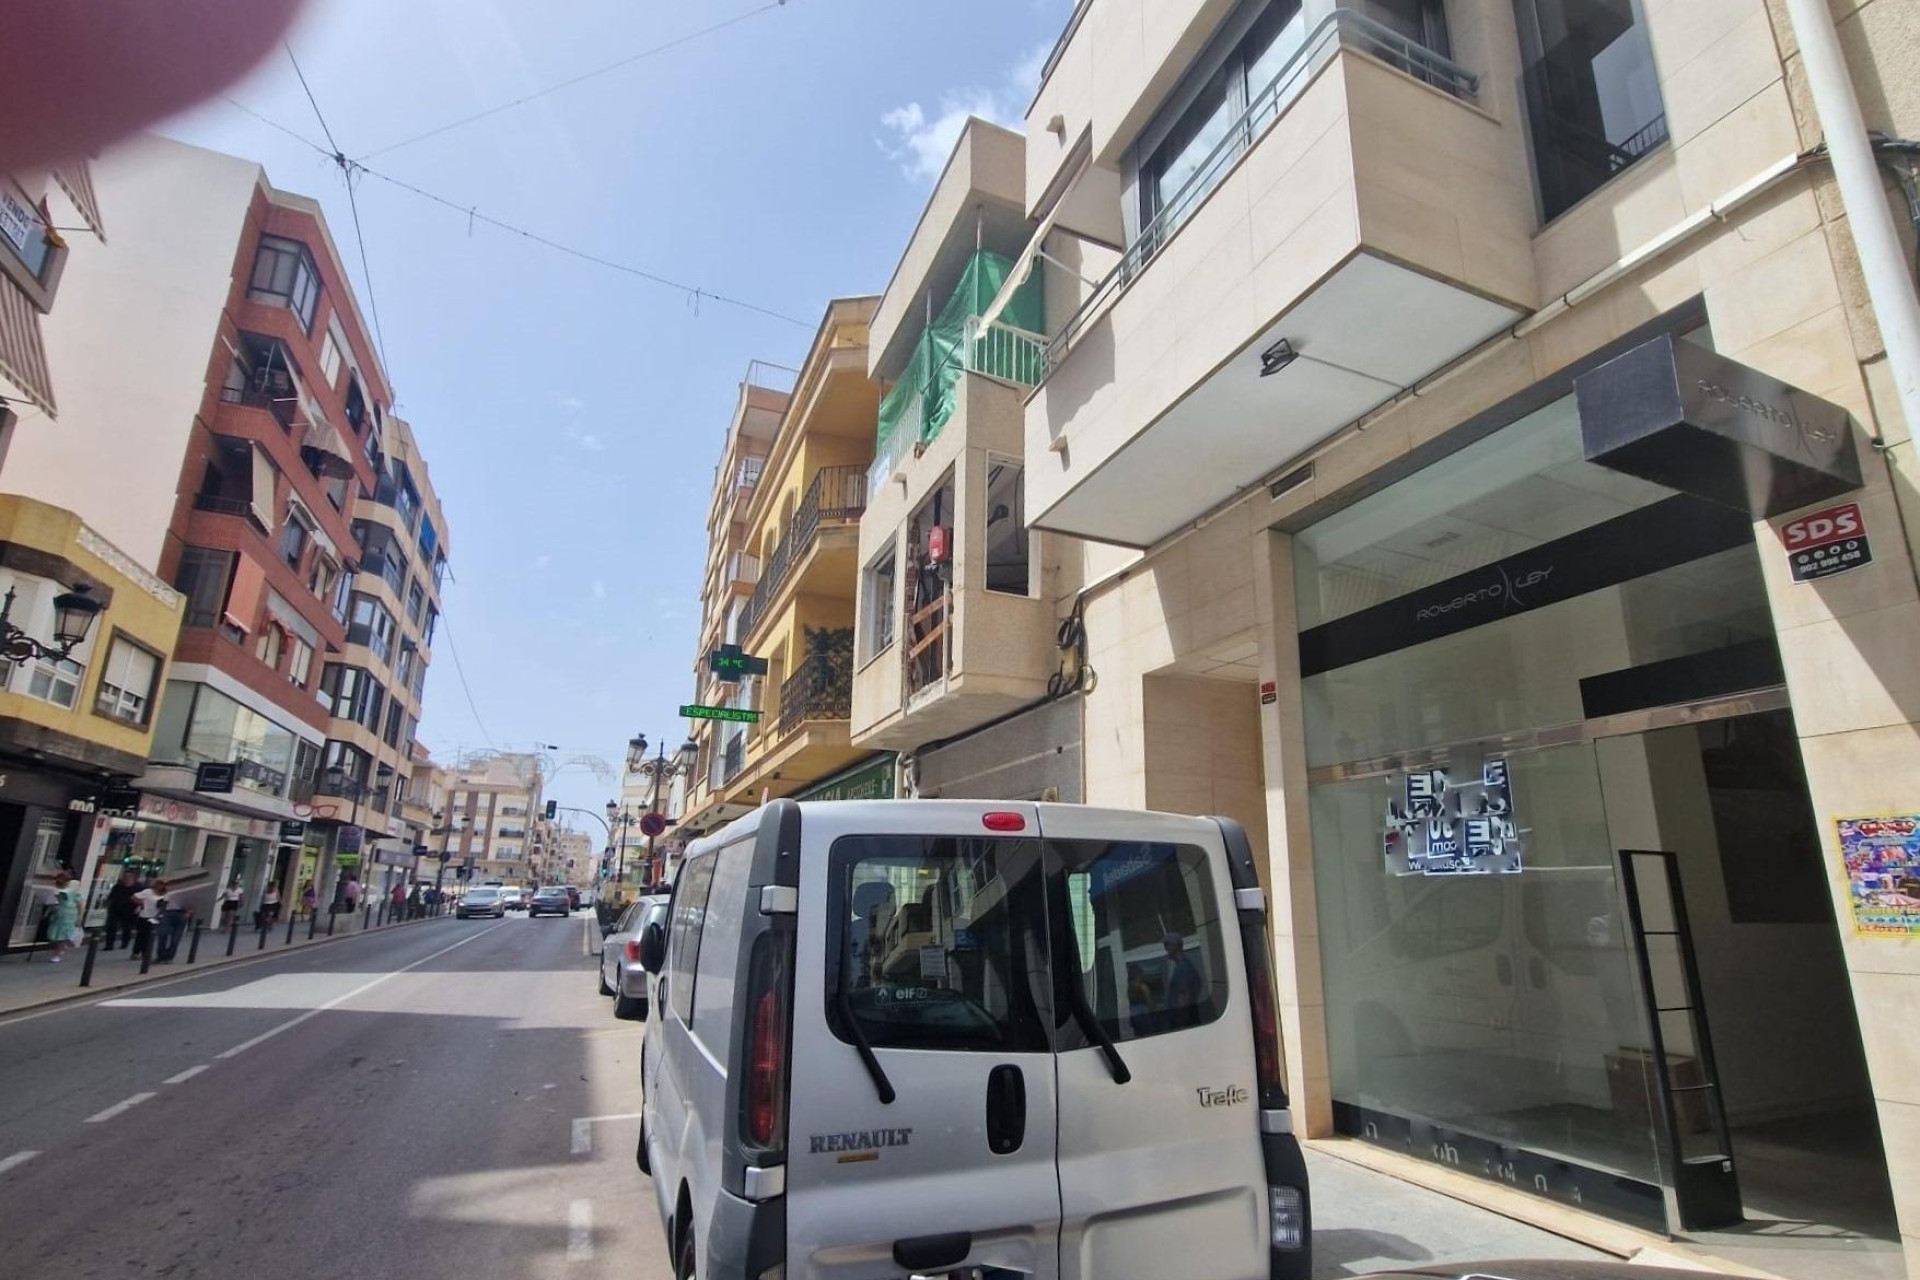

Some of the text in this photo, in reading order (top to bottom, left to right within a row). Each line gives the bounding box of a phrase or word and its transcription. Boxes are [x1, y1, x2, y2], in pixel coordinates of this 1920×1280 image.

[1787, 512, 1858, 544] SDS
[1416, 583, 1503, 621] ROBERTO
[1197, 1083, 1249, 1108] Trafic
[809, 1127, 913, 1154] RENAULT
